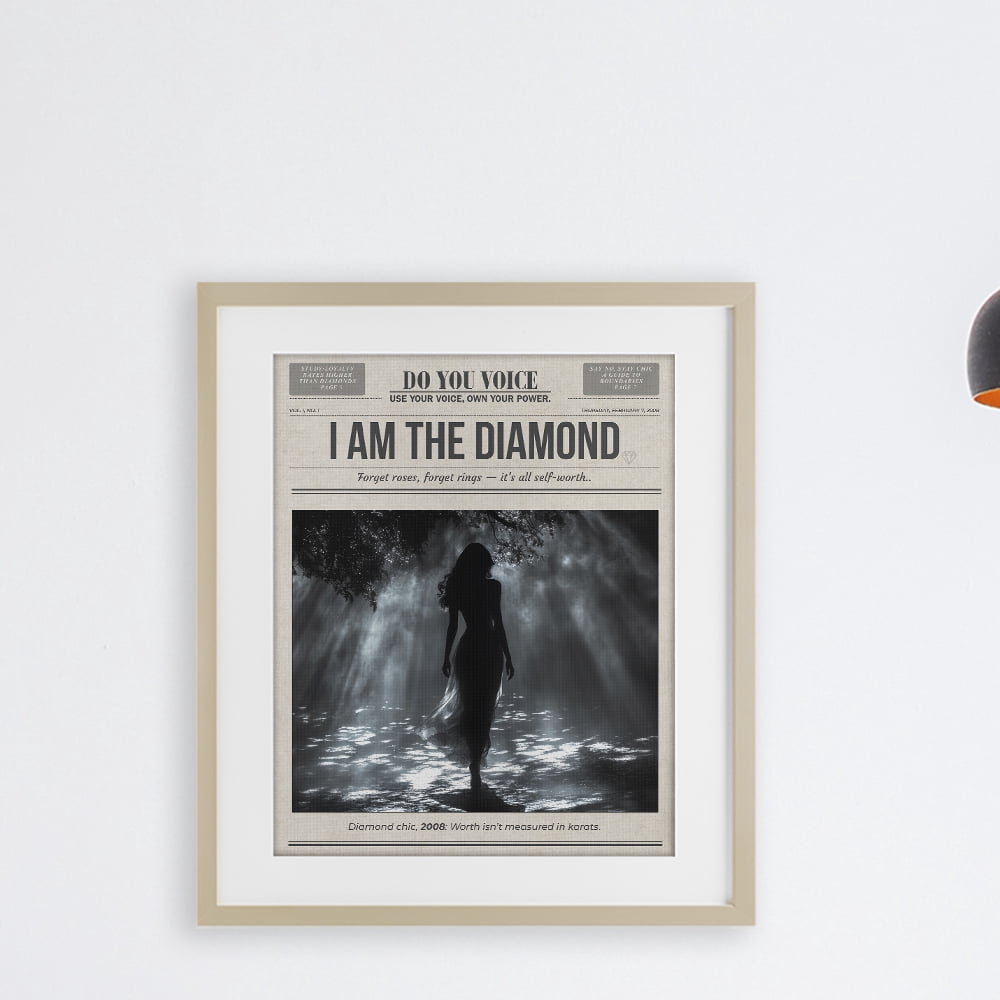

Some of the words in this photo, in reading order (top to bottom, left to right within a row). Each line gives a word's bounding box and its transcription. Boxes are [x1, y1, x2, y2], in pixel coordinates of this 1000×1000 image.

[403, 371, 430, 390] DO
[436, 371, 475, 390] YOU
[480, 371, 538, 390] VOICE
[390, 395, 407, 403] USE
[410, 395, 433, 403] YOUR
[436, 395, 465, 404] VOICE,
[467, 395, 487, 403] OWN
[490, 395, 513, 403] YOUR
[517, 395, 551, 403] POWER.
[330, 422, 337, 460] I
[347, 422, 395, 460] AM
[405, 422, 465, 460] THE
[475, 422, 620, 460] DIAMOND
[357, 472, 389, 484] Forget
[392, 474, 420, 484] roses,
[424, 472, 454, 484] forget
[457, 472, 483, 484] rings
[500, 472, 516, 482] it's
[519, 472, 531, 482] all
[534, 472, 592, 484] self-worth..
[348, 822, 394, 831] Diamond
[396, 822, 418, 832] chic,
[420, 822, 448, 831] 2008:
[450, 822, 480, 831] Worth
[482, 822, 504, 831] isn't
[504, 822, 554, 831] measured
[555, 822, 565, 831] in
[567, 822, 601, 831] karats.
